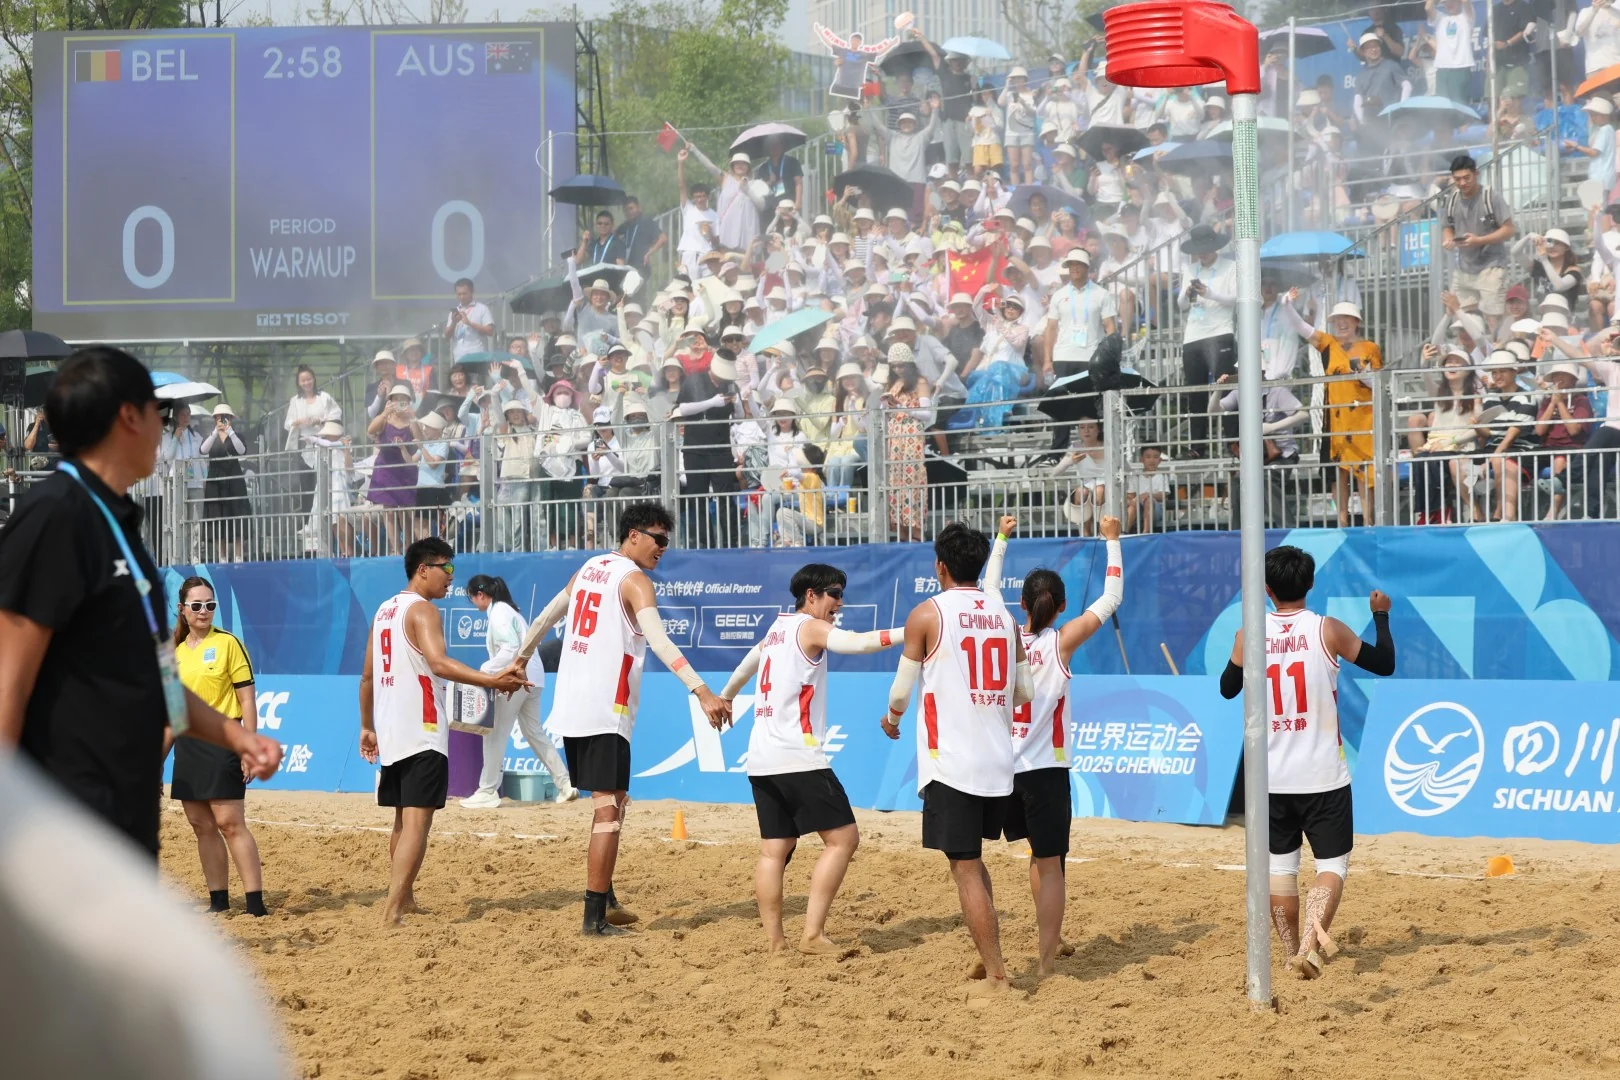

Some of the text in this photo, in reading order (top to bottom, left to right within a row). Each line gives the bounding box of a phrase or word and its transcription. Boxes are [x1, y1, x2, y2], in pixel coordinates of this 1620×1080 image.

[131, 48, 199, 82] BEL
[262, 46, 343, 80] 2:58
[396, 43, 475, 77] AUS
[269, 217, 337, 236] PERIOD
[431, 199, 485, 285] 0
[122, 204, 175, 290] 0
[249, 245, 357, 280] WARMUP
[283, 312, 351, 326] TISSOT
[705, 582, 732, 594] Official
[732, 582, 763, 594] Partner
[572, 589, 602, 638] 16
[714, 615, 764, 627] GEELY
[959, 612, 1005, 630] CHINA
[380, 628, 391, 672] 9
[960, 636, 1008, 690] 10
[760, 655, 772, 701] 4
[1266, 661, 1308, 716] 11
[255, 691, 290, 730] CC
[1271, 717, 1307, 732] 李文静
[1072, 755, 1196, 776] 2025 CHENGDU
[1492, 787, 1615, 813] SICHUAN
